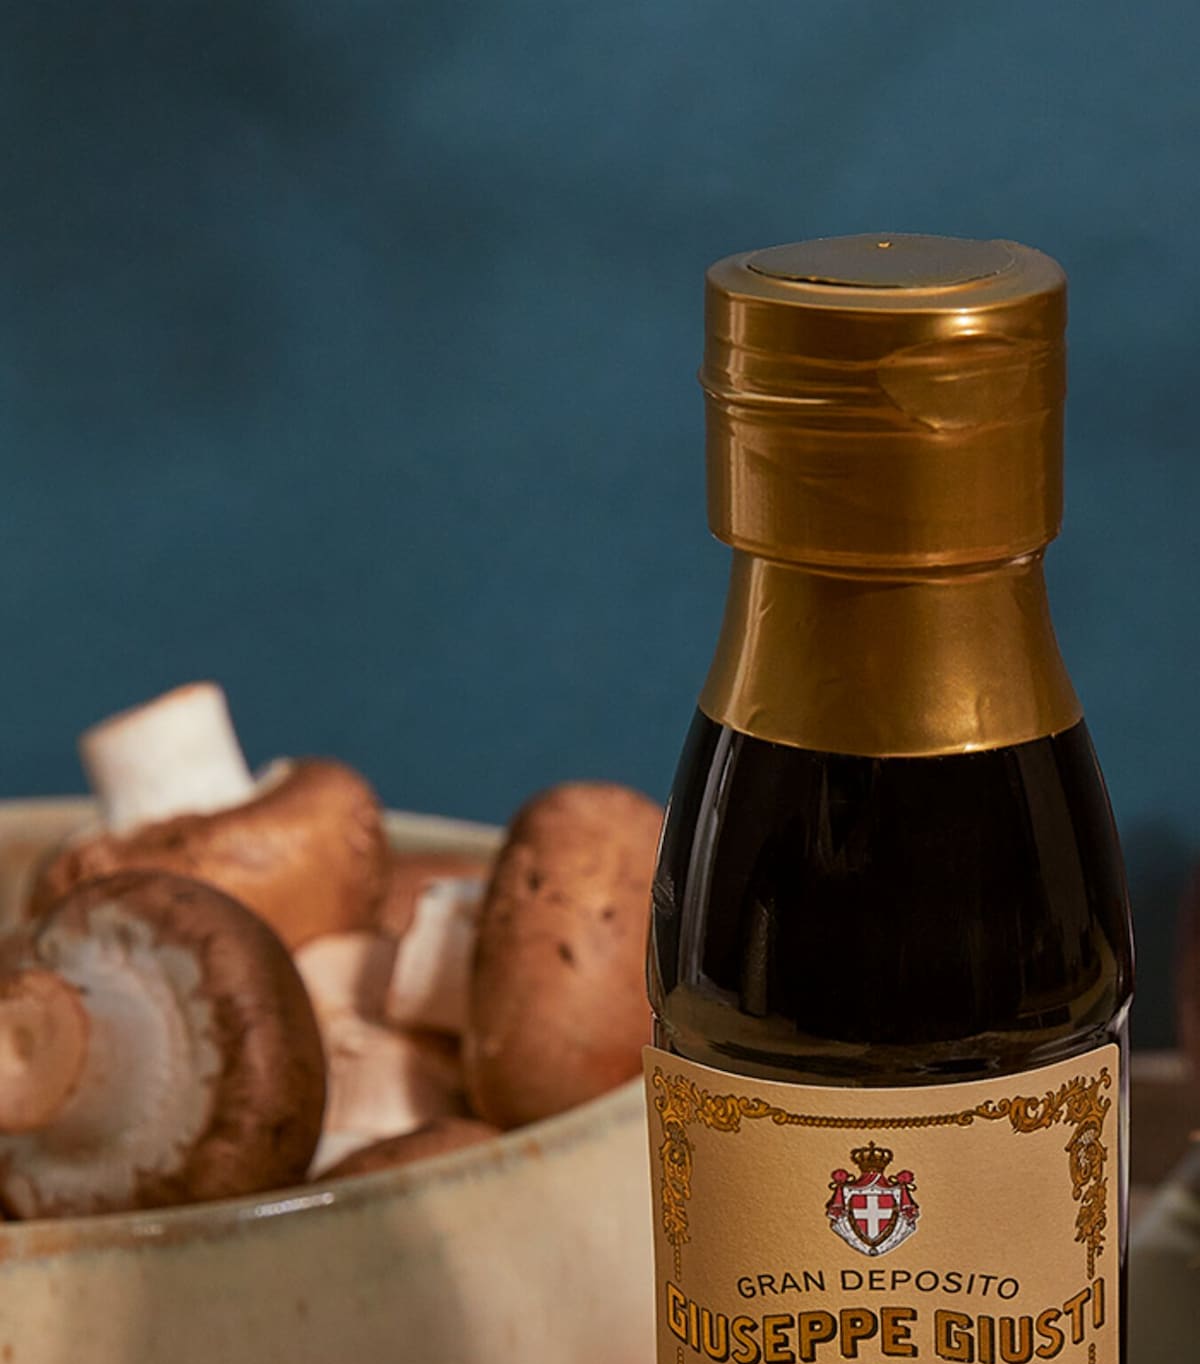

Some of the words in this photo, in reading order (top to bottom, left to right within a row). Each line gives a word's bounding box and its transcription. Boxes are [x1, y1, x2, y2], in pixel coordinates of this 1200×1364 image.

[737, 1270, 825, 1299] GRAN
[841, 1269, 1020, 1300] DEPOSITO
[934, 1277, 1105, 1364] GIUSTI
